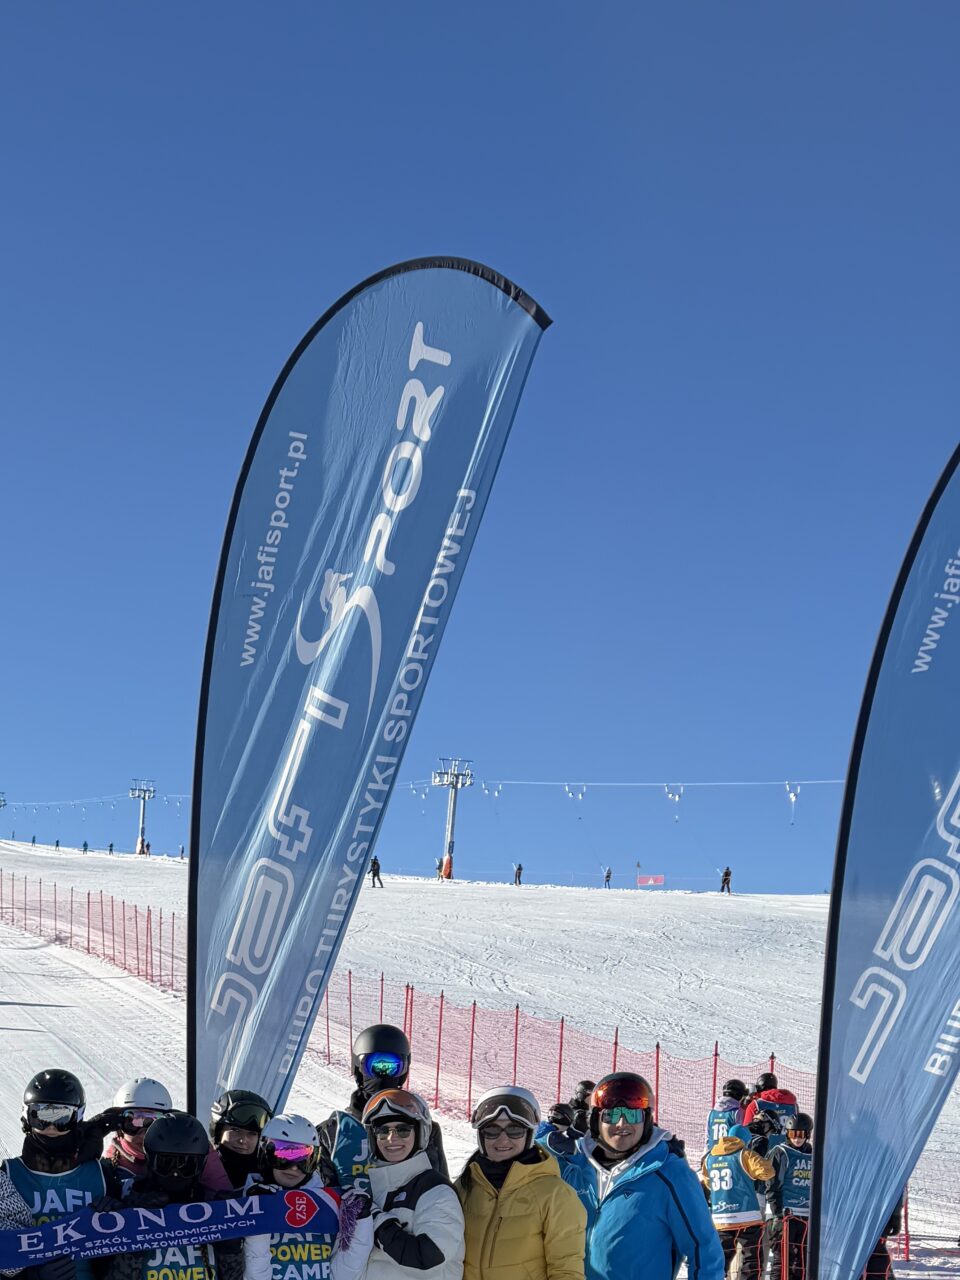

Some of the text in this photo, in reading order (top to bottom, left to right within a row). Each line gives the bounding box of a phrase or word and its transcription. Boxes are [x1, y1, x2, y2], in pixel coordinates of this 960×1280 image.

[240, 431, 308, 667] www.jafisport.pl
[911, 548, 960, 673] www.jafi
[318, 755, 398, 954] TURYSTYKI
[384, 488, 476, 744] SPORTOWEJ
[794, 1159, 813, 1170] JAF
[710, 1169, 733, 1191] 33
[295, 1196, 307, 1221] ZSE
[17, 1195, 265, 1252] EKONOM
[84, 1235, 132, 1248] SZKÓŁ
[137, 1219, 256, 1242] EKONOMICZNYCH
[80, 1245, 128, 1258] MIŃSKU
[131, 1232, 222, 1251] MAZOWIECKIM
[271, 1263, 332, 1280] CAMP
